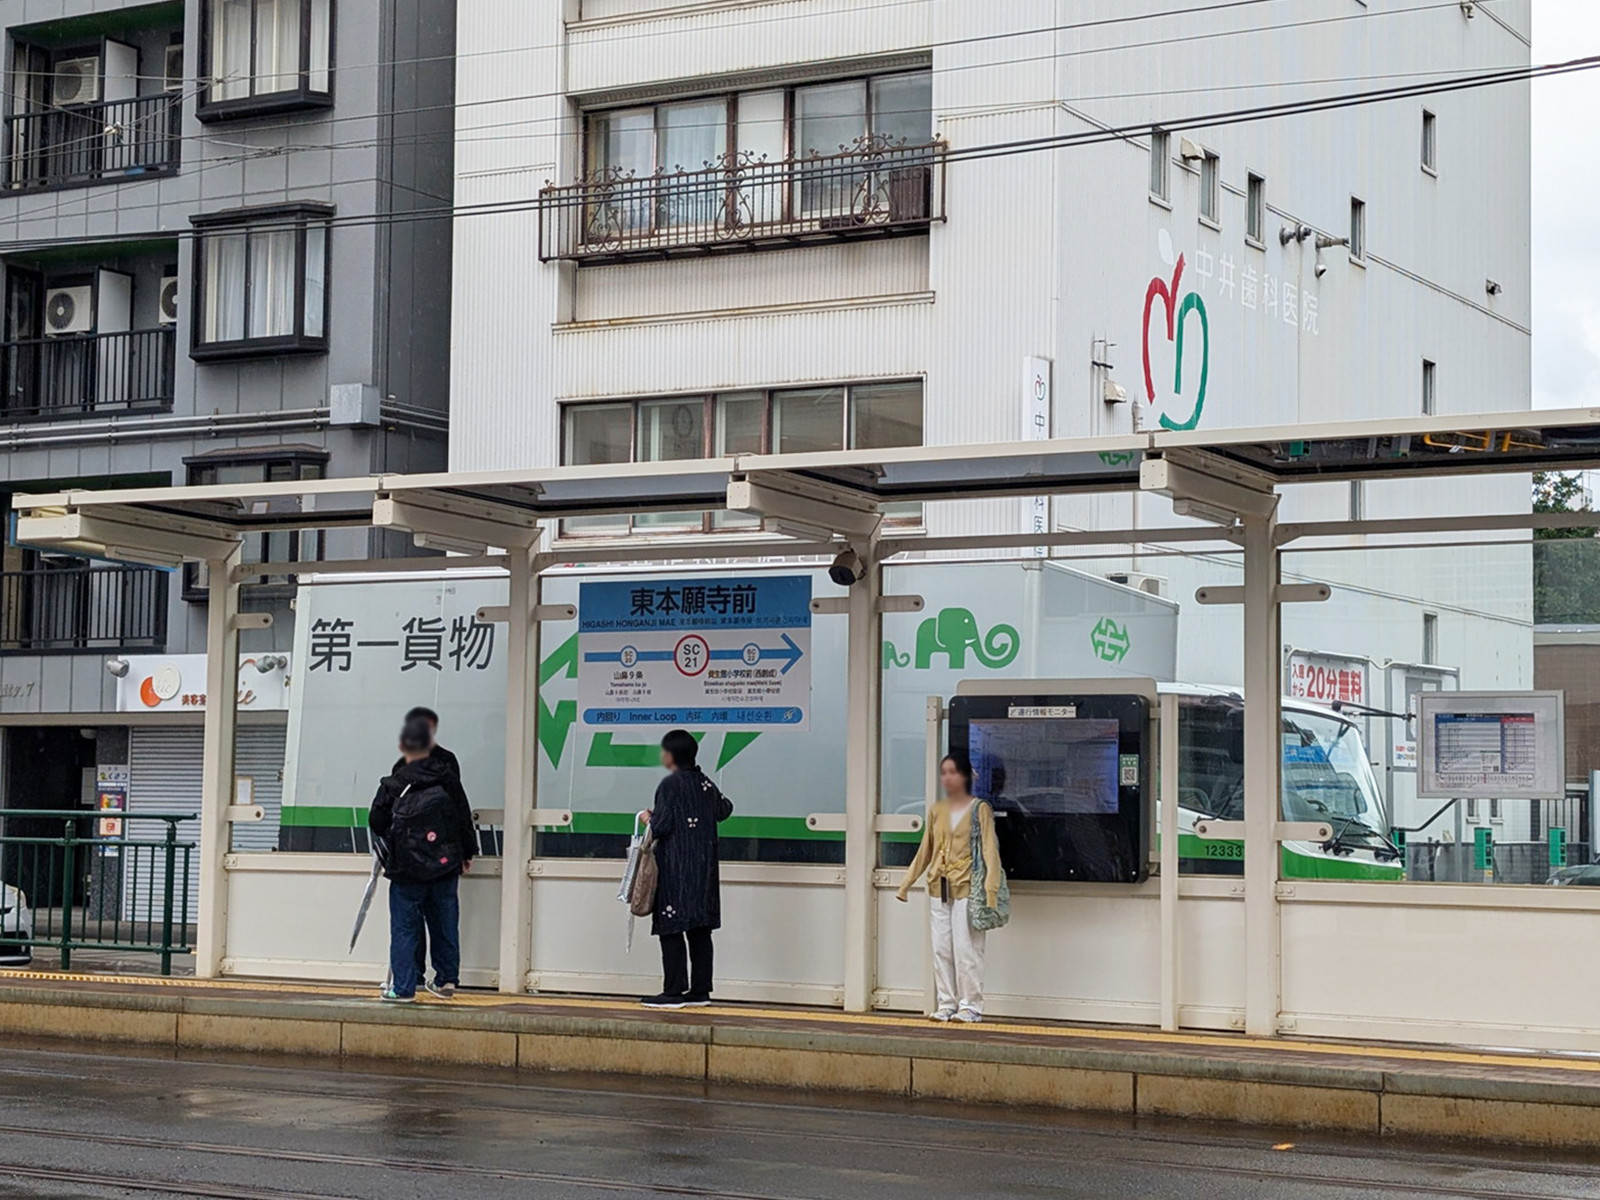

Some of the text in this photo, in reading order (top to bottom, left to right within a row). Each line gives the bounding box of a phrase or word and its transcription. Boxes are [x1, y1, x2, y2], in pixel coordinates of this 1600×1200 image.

[1195, 244, 1319, 335] 中井歯科医院
[630, 584, 757, 616] 東本願寺前
[582, 620, 614, 629] HIGASHI
[616, 619, 657, 628] HONGANJI
[659, 618, 676, 627] MAE
[309, 615, 495, 672] 第一貨物
[683, 644, 700, 656] SC
[684, 658, 698, 668] 21
[1306, 664, 1362, 702] 20分無料
[596, 711, 621, 722] 内回り
[629, 711, 678, 722] Inner Loop
[1018, 708, 1075, 716] 運行情報モニター
